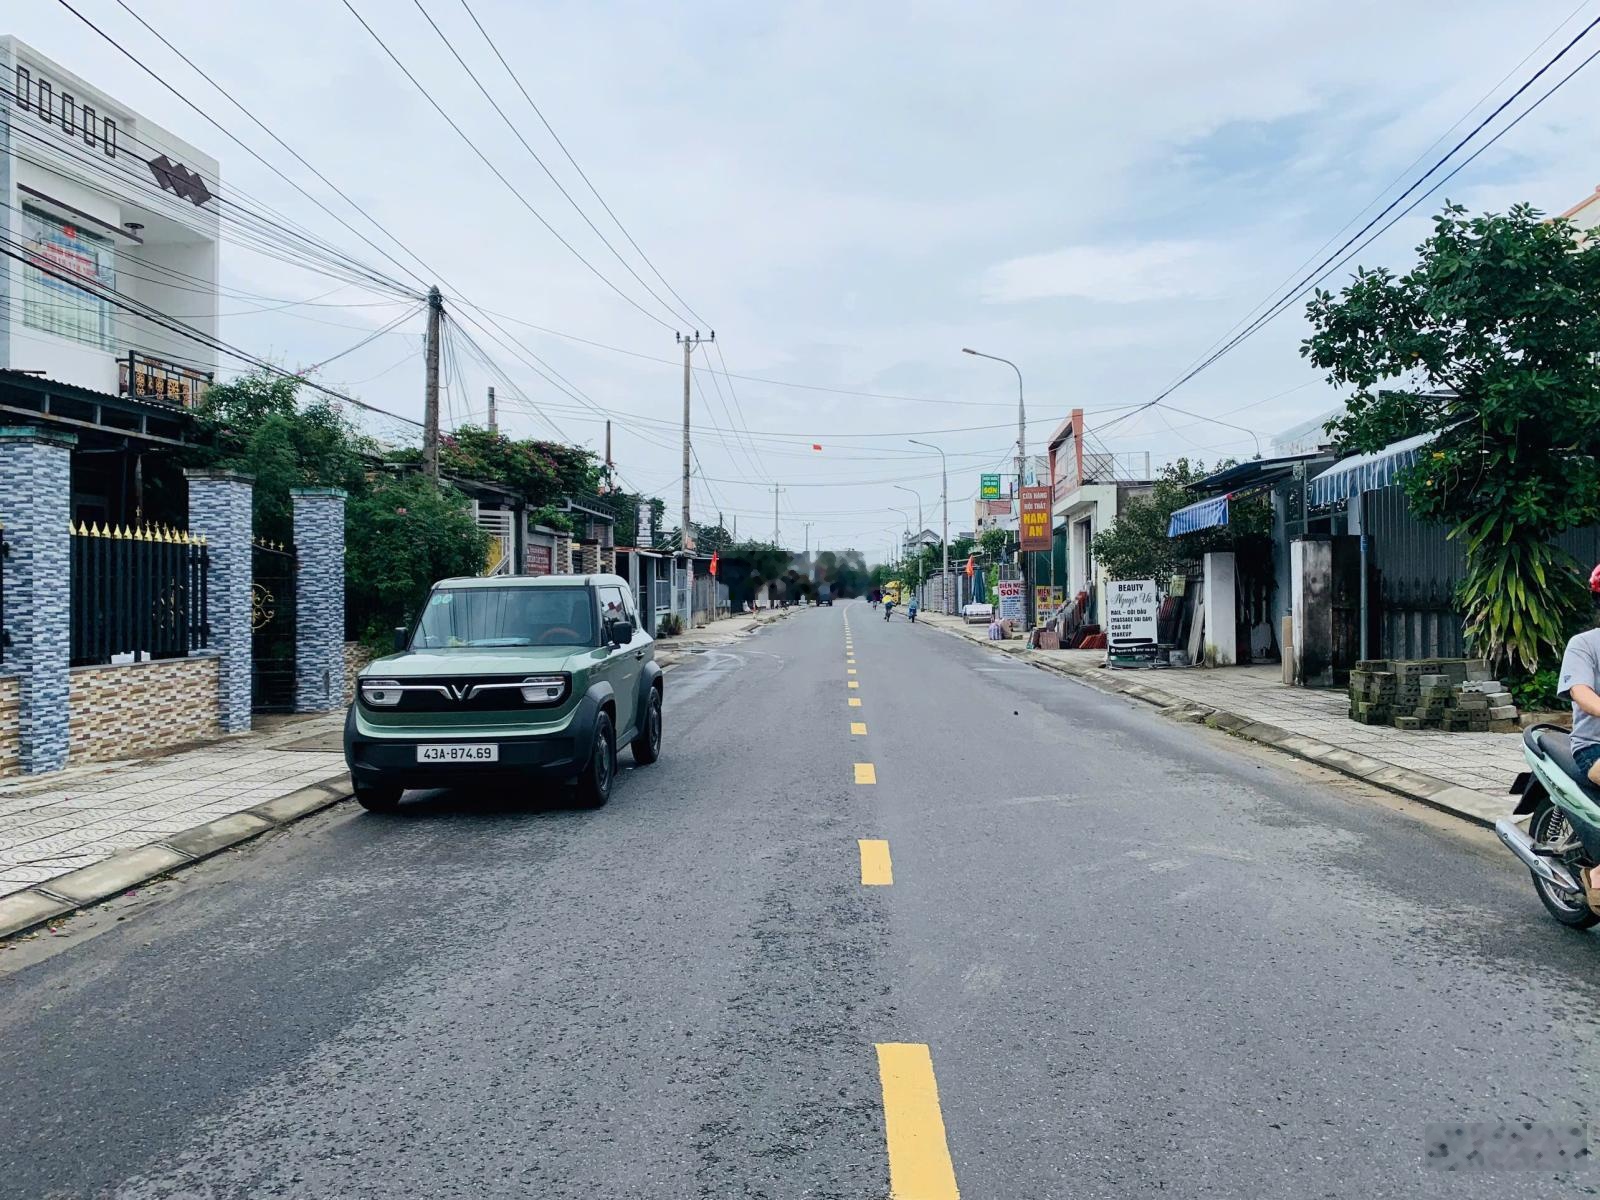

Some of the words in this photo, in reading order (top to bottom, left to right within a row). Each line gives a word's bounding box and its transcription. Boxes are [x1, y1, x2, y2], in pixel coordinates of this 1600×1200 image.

[1023, 512, 1048, 524] NAM
[1028, 525, 1043, 537] AN
[1118, 584, 1144, 592] BEAUTY
[424, 747, 492, 760] 43A-874.69
